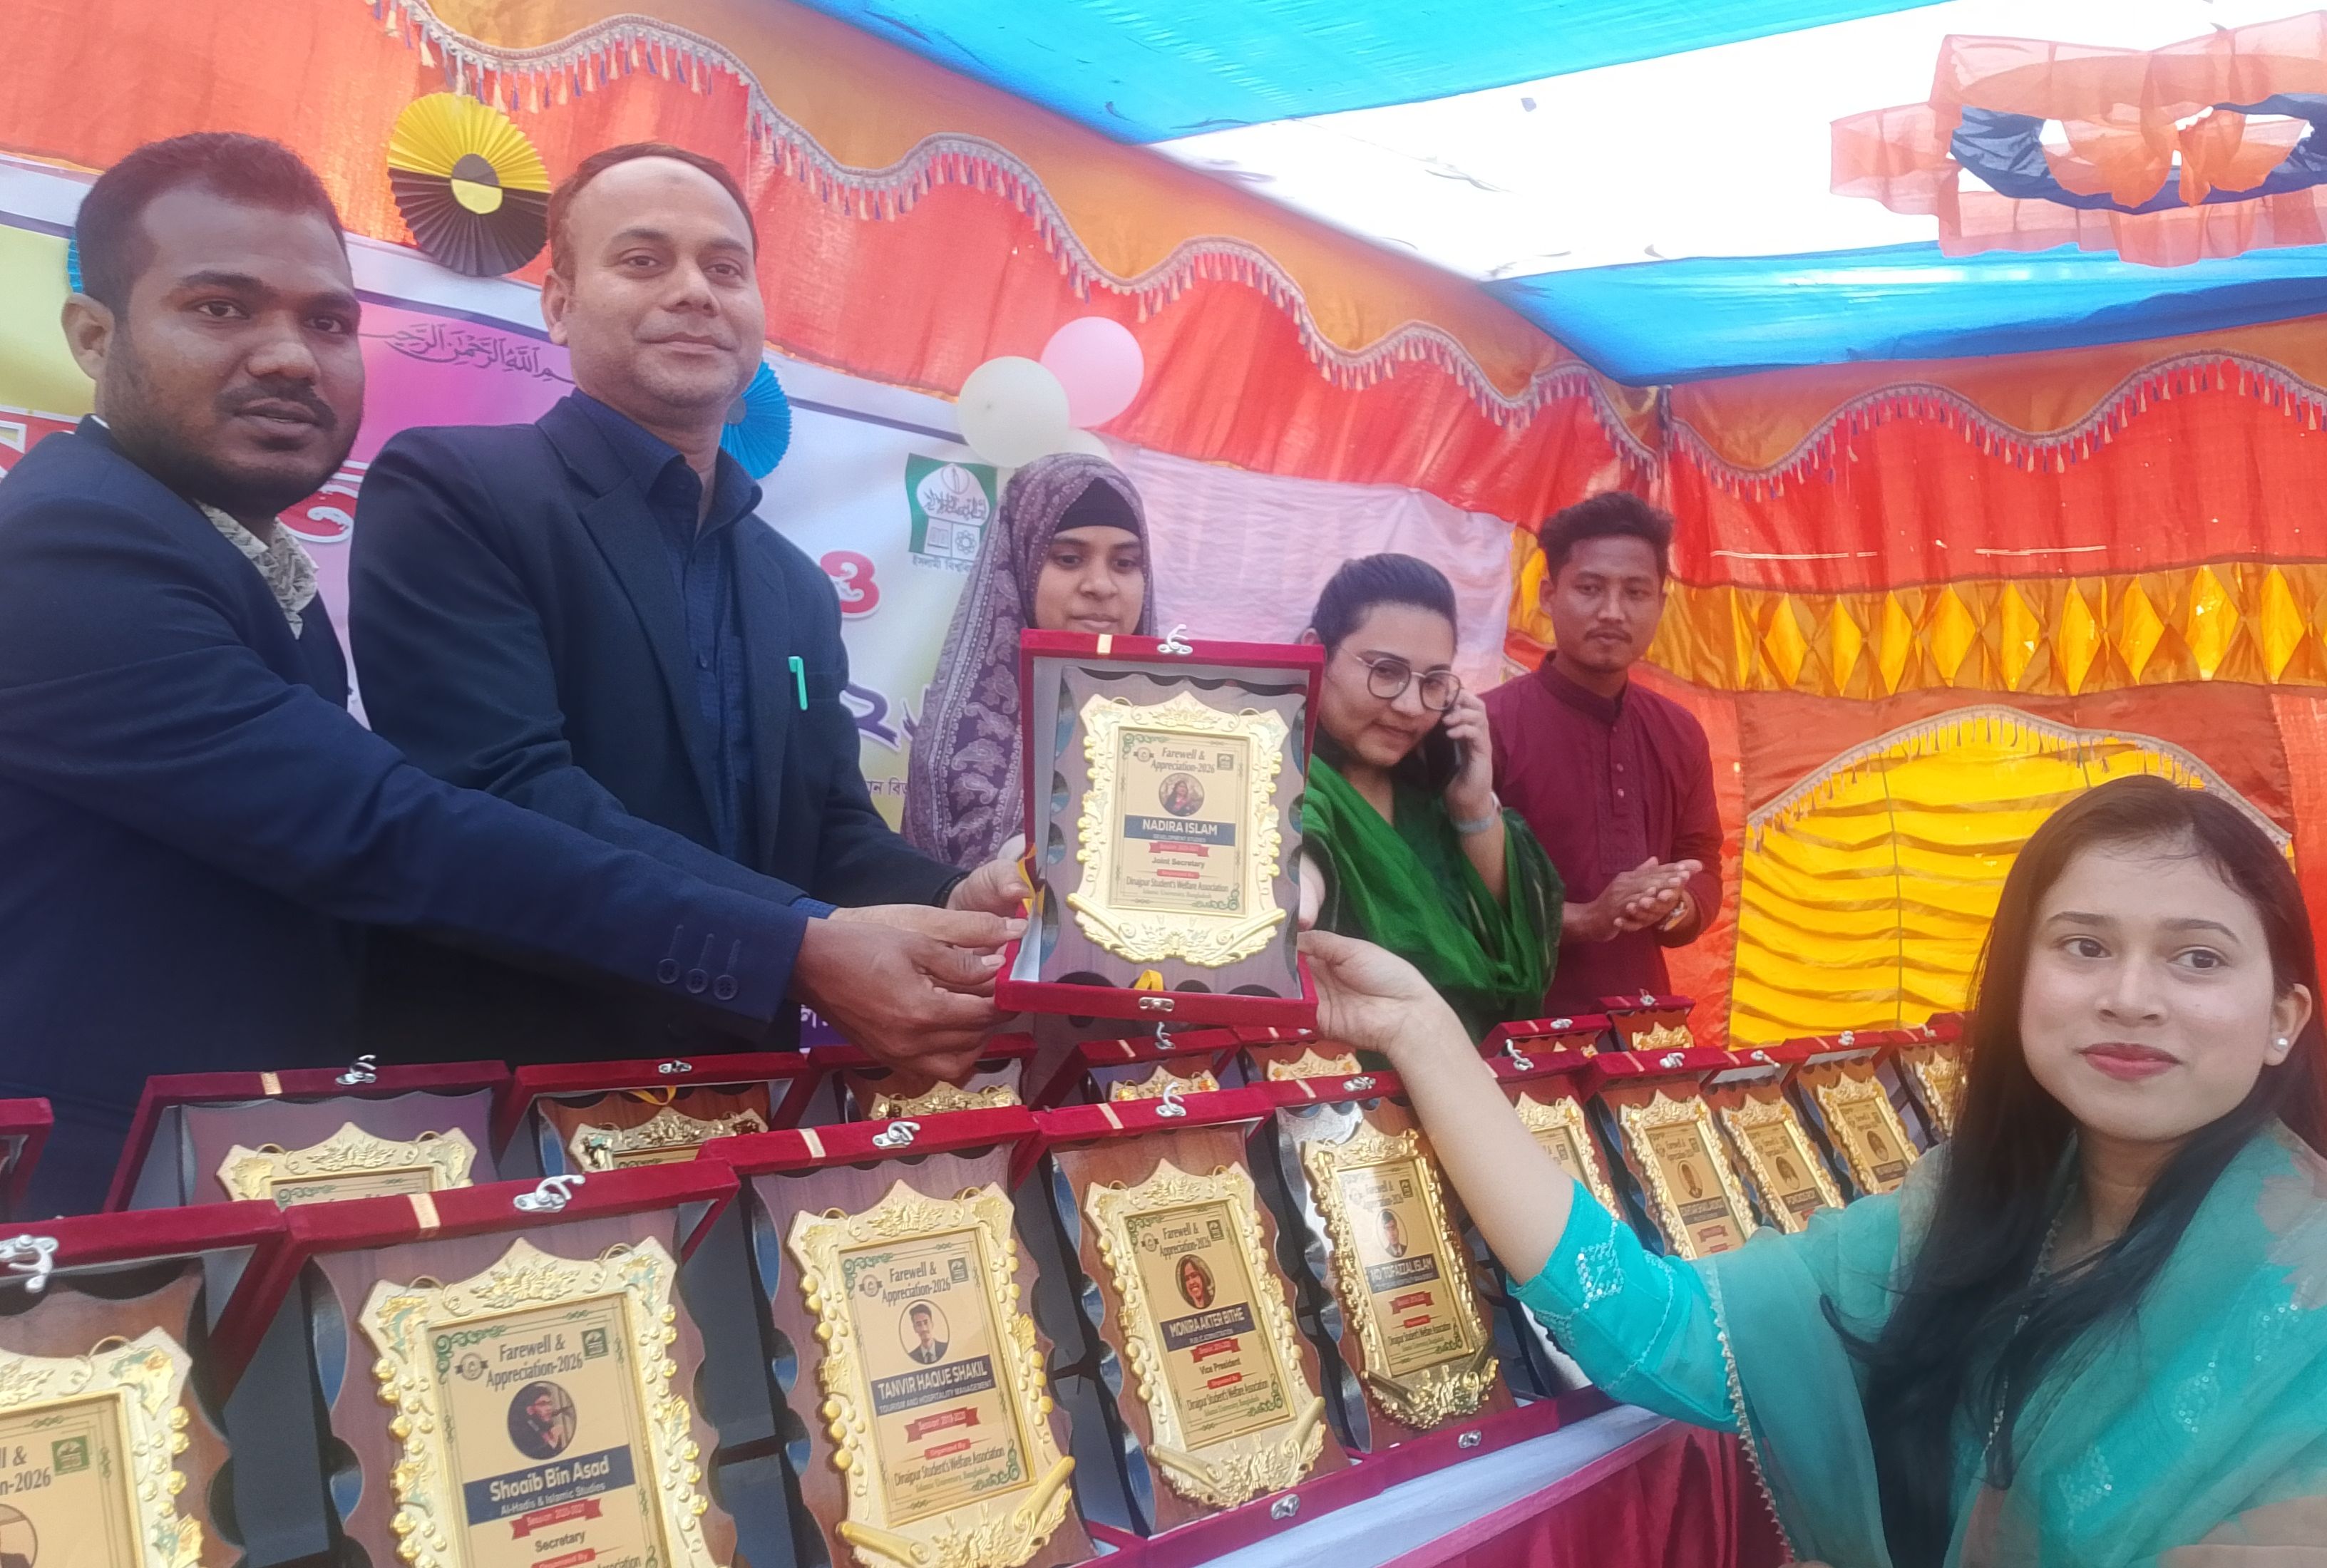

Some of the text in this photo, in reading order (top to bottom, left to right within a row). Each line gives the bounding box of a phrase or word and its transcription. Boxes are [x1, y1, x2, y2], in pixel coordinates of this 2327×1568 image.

[1162, 747, 1206, 760] Farewell &
[1142, 819, 1218, 836] NADIRA ISLAM
[1171, 859, 1206, 869] Secretary
[1163, 1222, 1191, 1239] Farewell
[889, 1261, 937, 1283] Farewell &
[881, 1276, 951, 1307] Appreciation-2026
[1169, 1307, 1245, 1338] MONIRA AKTER BITHE
[498, 1333, 565, 1363] Farewell &
[486, 1351, 583, 1393] Appreciation-2026
[1199, 1357, 1241, 1375] Vice President
[878, 1361, 987, 1401] TANVIR HAQUE SHAKIL
[12, 1445, 27, 1466] &
[894, 1470, 921, 1487] Dinajpur
[972, 1446, 1005, 1464] Association
[490, 1455, 610, 1502] Shoaib Bin Asad
[537, 1496, 545, 1507] &
[545, 1490, 575, 1505] Islamic
[575, 1482, 606, 1497] Studies
[535, 1531, 586, 1553] Secretary
